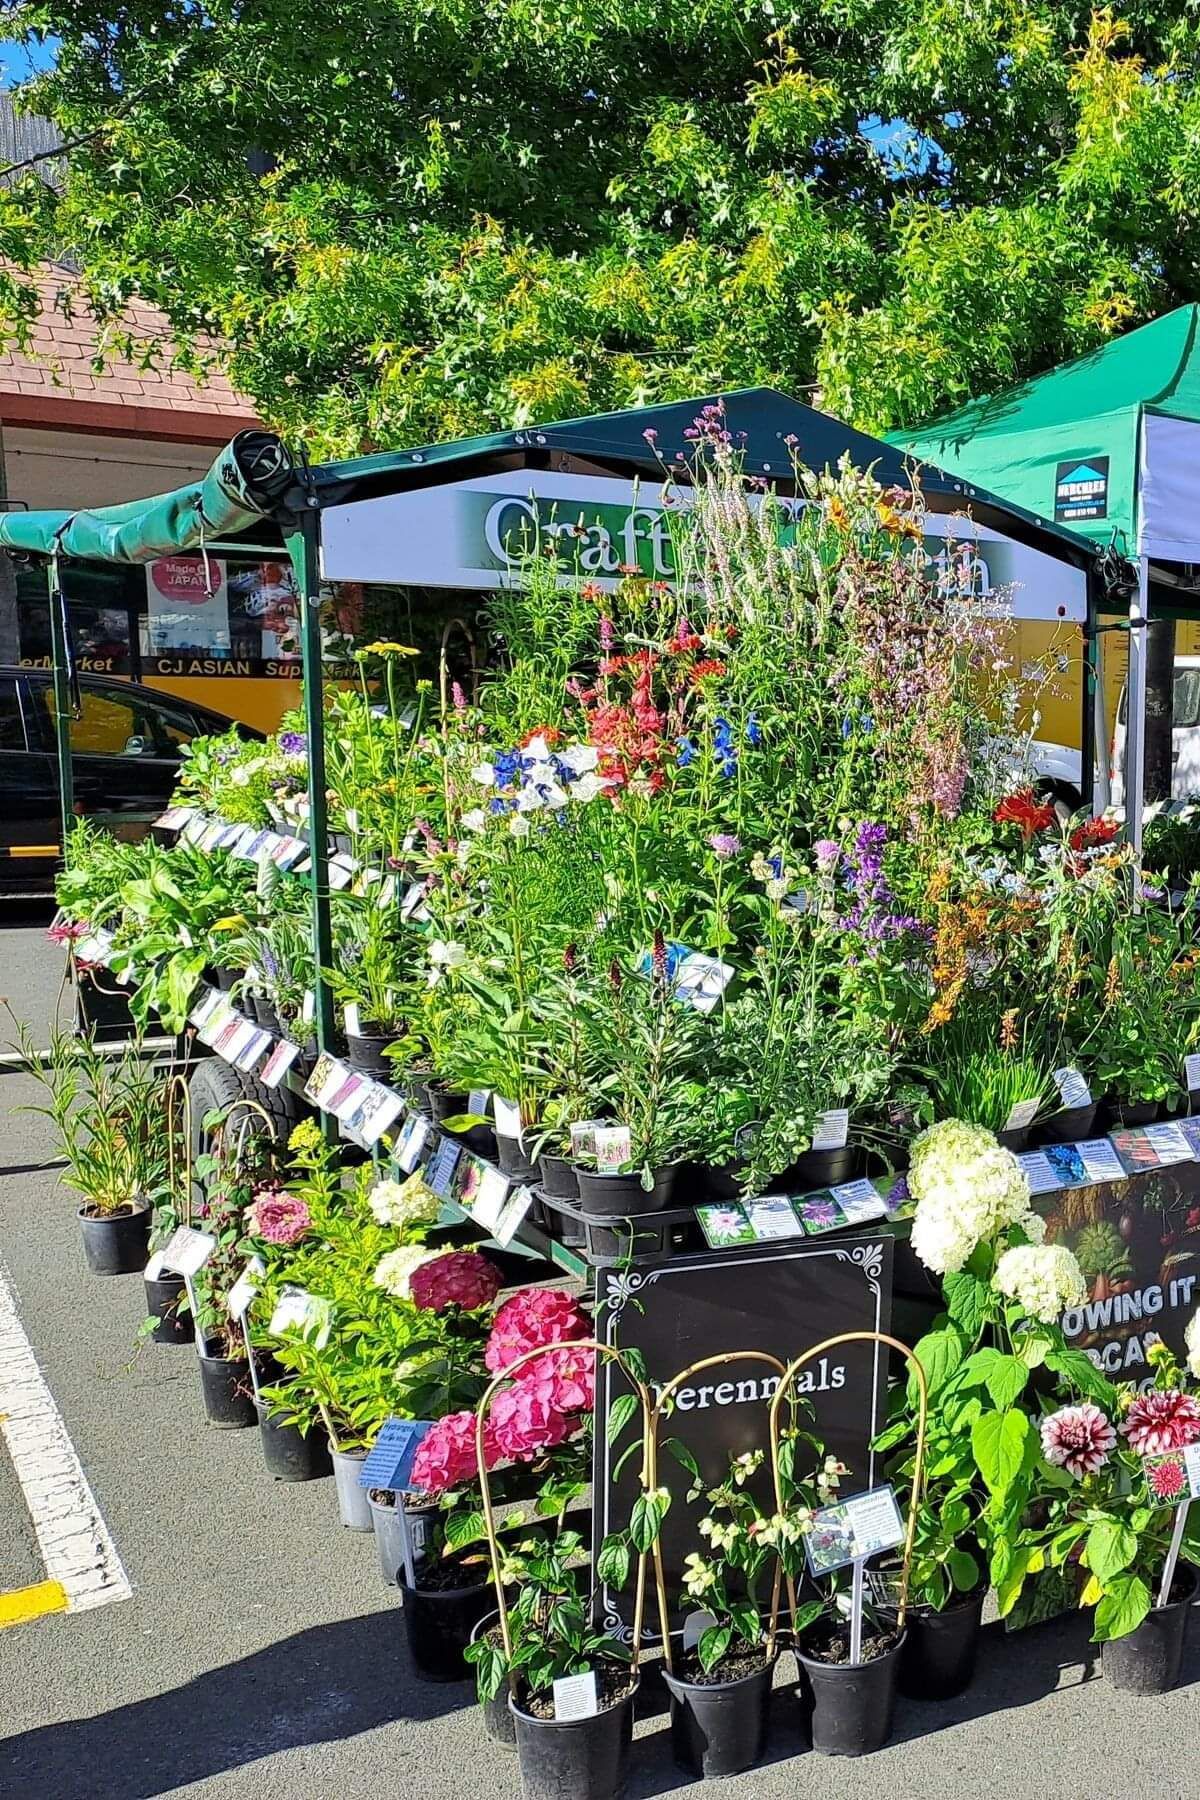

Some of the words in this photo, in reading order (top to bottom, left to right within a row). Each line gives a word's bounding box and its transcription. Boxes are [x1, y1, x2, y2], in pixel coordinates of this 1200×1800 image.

[484, 497, 677, 577] Craft
[157, 659, 183, 674] CJ
[188, 660, 250, 675] ASIAN
[1059, 1284, 1164, 1337] OWING
[1169, 1275, 1197, 1308] IT
